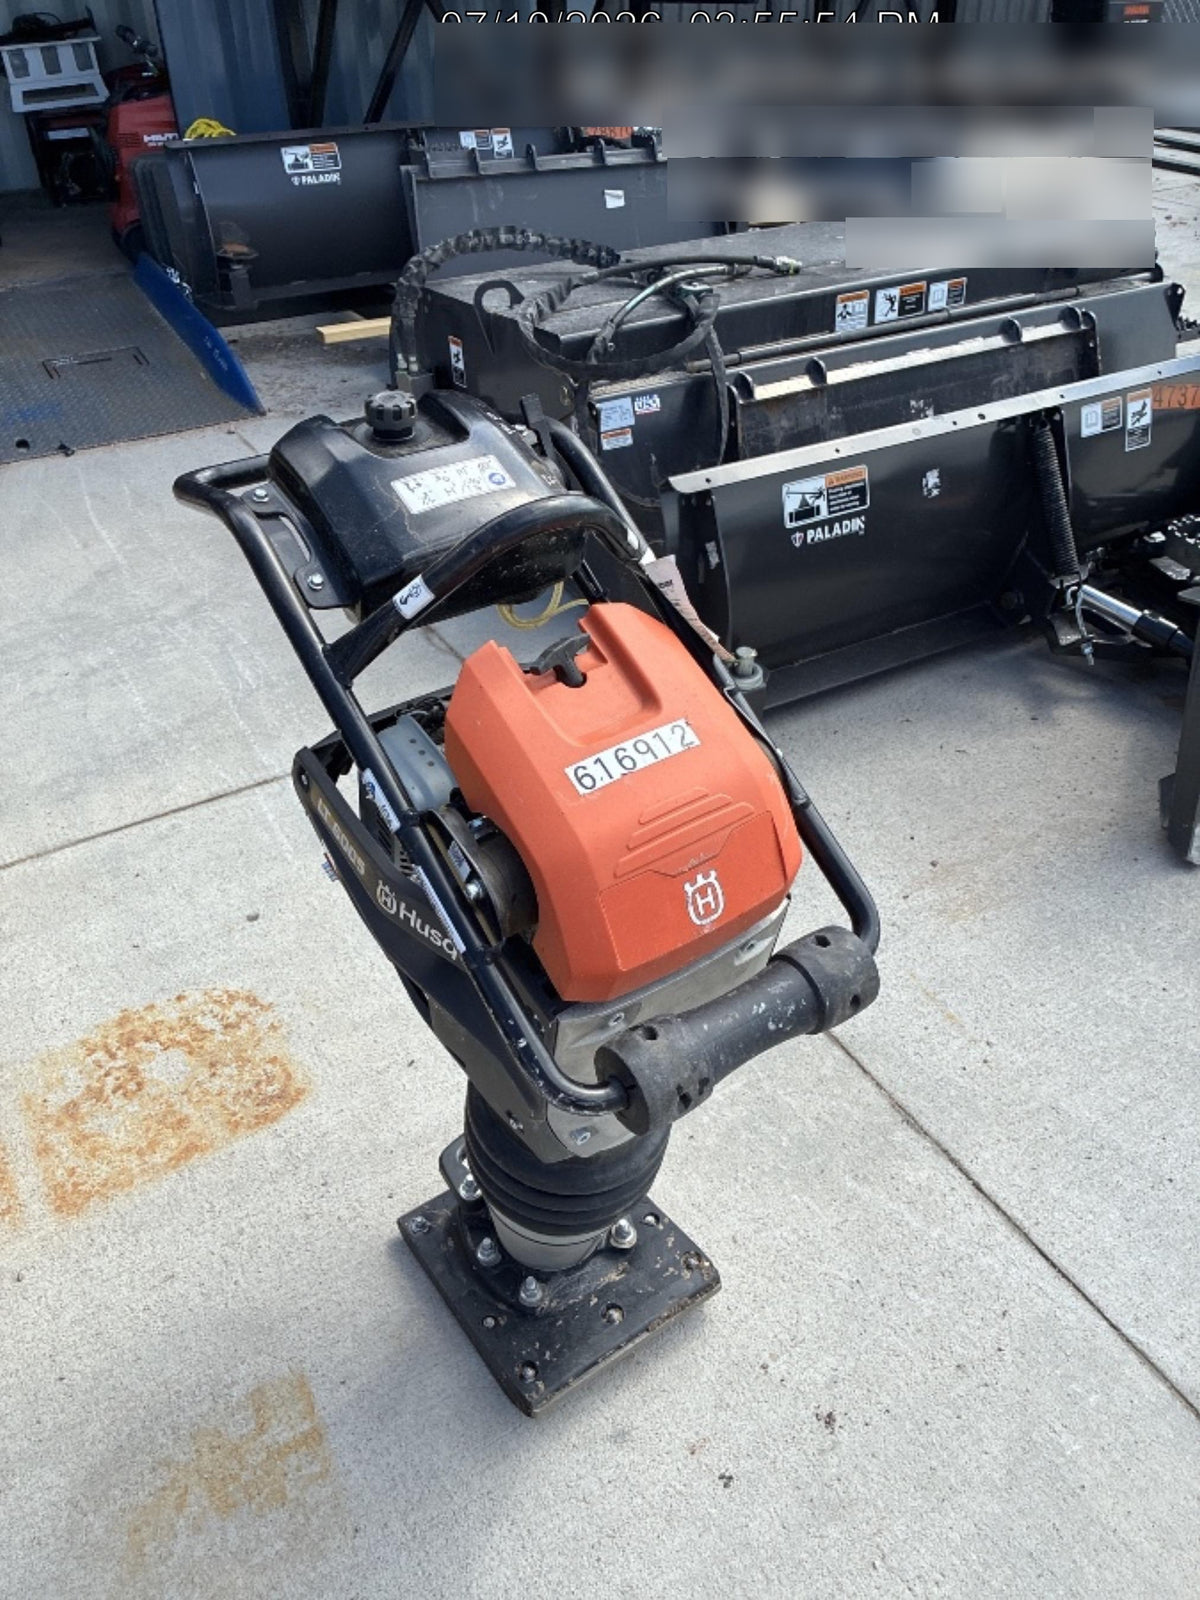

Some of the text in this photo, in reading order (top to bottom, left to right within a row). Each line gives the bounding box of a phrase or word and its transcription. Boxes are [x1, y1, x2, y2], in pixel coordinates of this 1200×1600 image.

[806, 516, 865, 544] PALADIN
[573, 724, 695, 790] 616912
[399, 901, 457, 960] Husq
